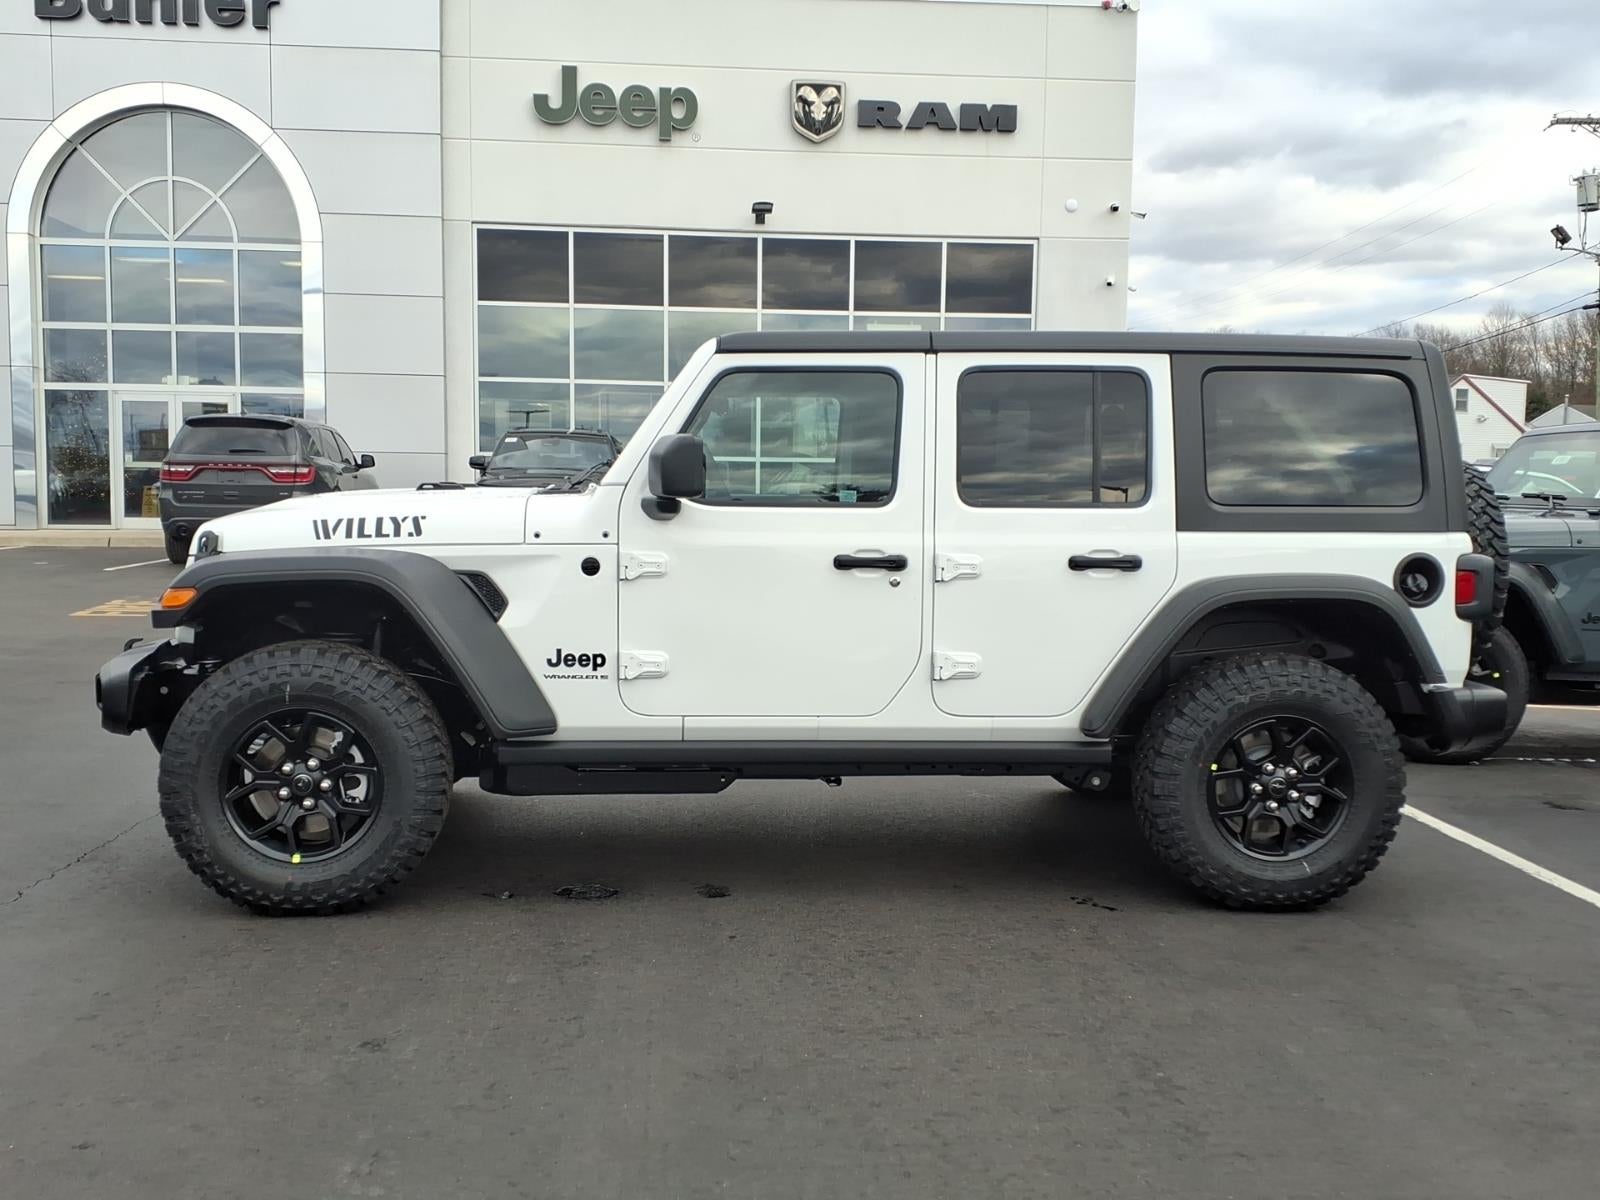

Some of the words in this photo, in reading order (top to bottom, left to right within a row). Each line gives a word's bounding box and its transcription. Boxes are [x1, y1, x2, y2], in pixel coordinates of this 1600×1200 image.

[533, 65, 699, 142] Jeep
[857, 99, 1018, 133] RAM
[312, 515, 427, 541] WILLYS
[546, 648, 606, 672] Jeep
